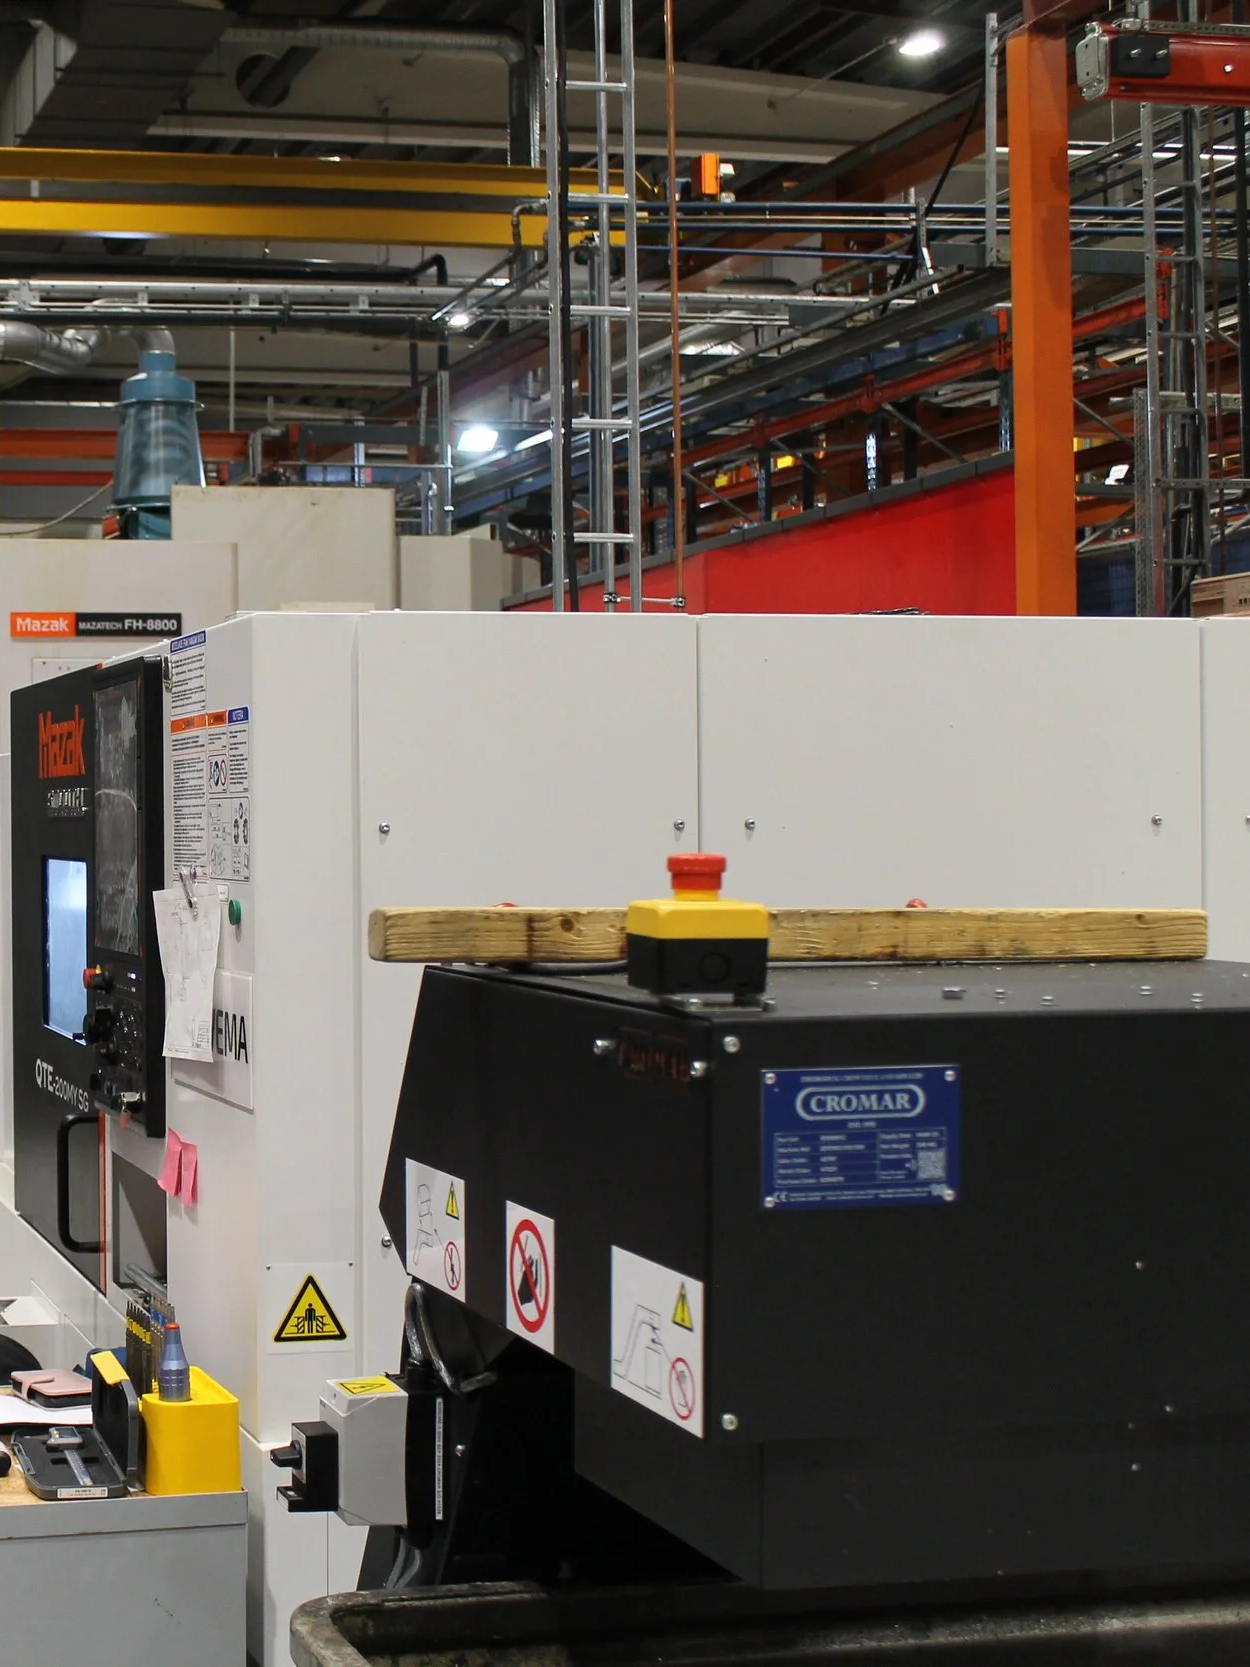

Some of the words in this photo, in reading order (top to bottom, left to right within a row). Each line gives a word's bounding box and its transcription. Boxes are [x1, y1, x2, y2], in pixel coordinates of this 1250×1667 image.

[16, 617, 69, 632] Mazak
[78, 621, 122, 630] MAZATECH
[124, 618, 177, 631] FH-8800
[38, 704, 86, 779] Mazak
[78, 1088, 89, 1113] SG
[810, 1092, 912, 1113] CROMAR
